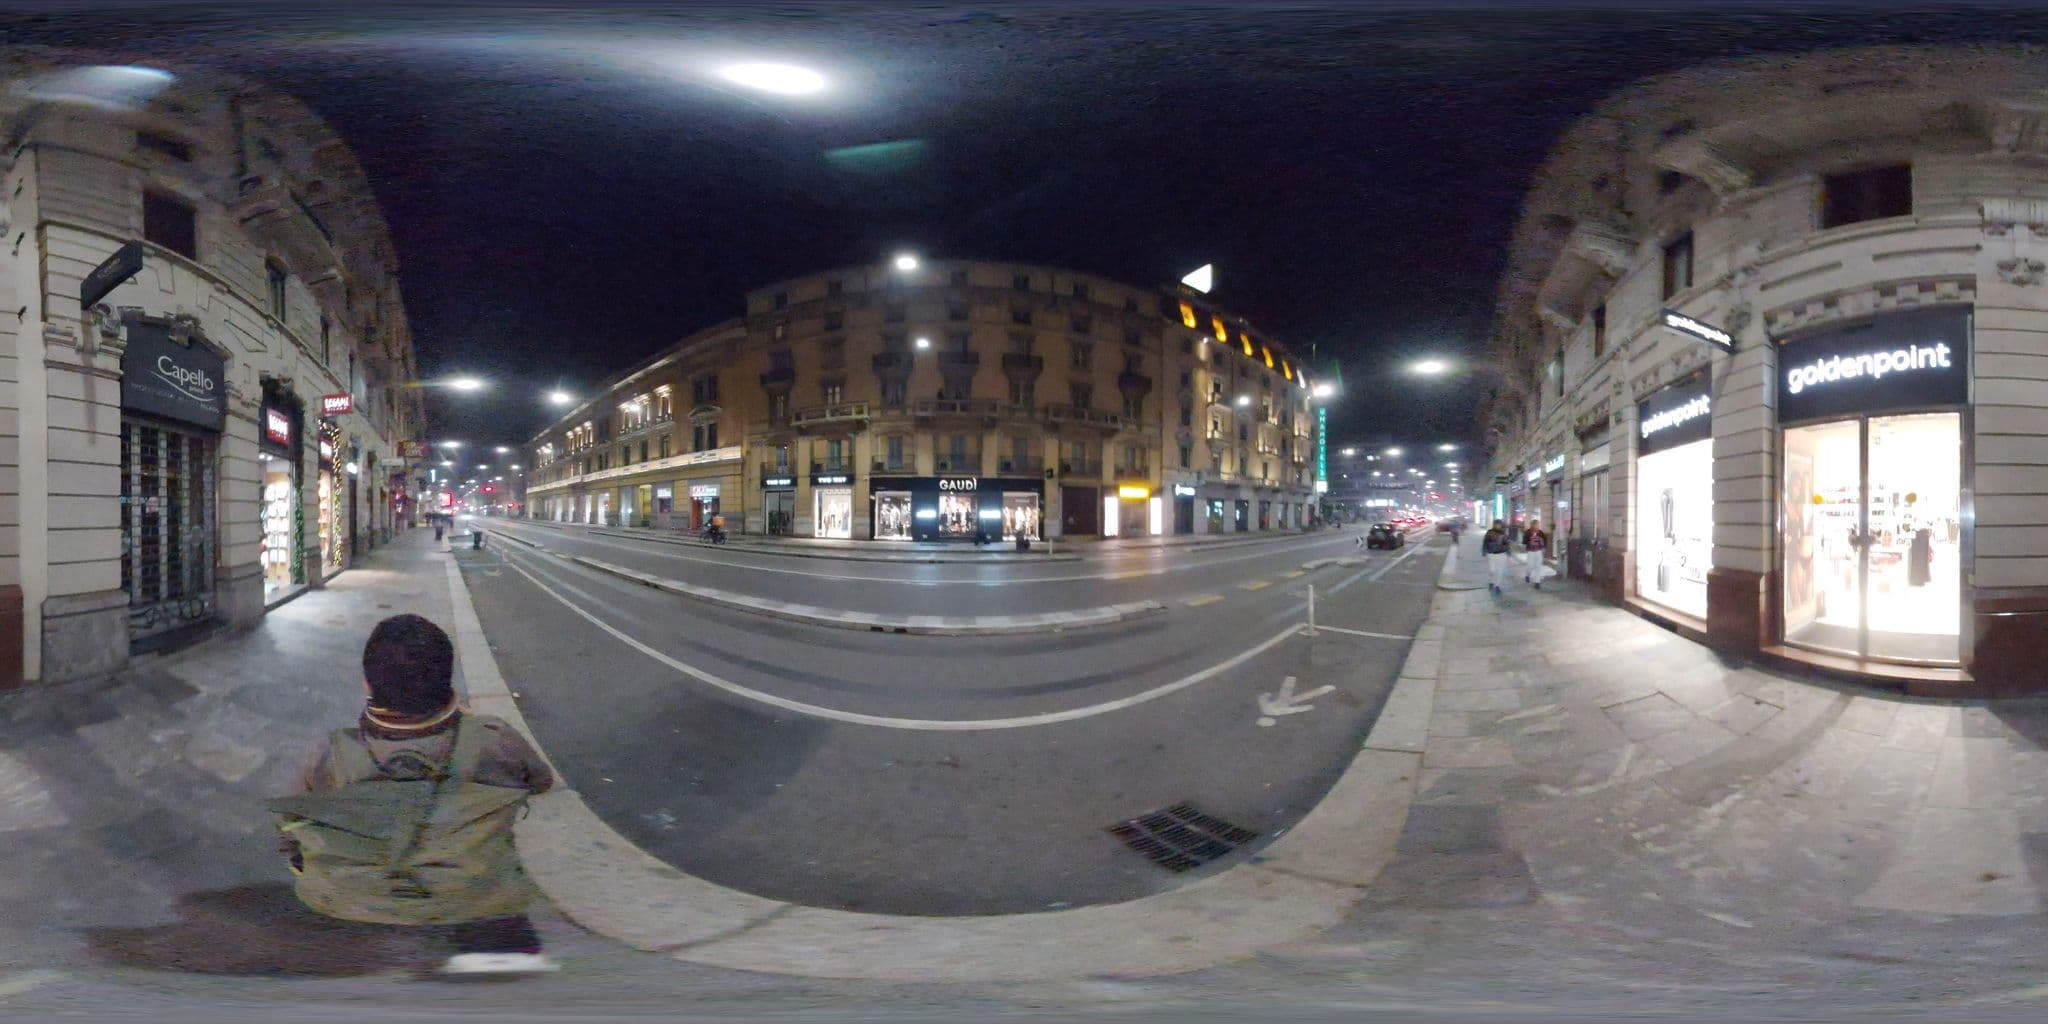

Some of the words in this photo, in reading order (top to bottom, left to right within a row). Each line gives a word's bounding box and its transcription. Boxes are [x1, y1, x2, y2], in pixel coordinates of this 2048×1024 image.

[157, 355, 214, 391] Capello
[1788, 342, 1951, 394] goldenpoint
[1642, 394, 1710, 439] goldenpoint
[939, 477, 977, 490] GAUDÌ
